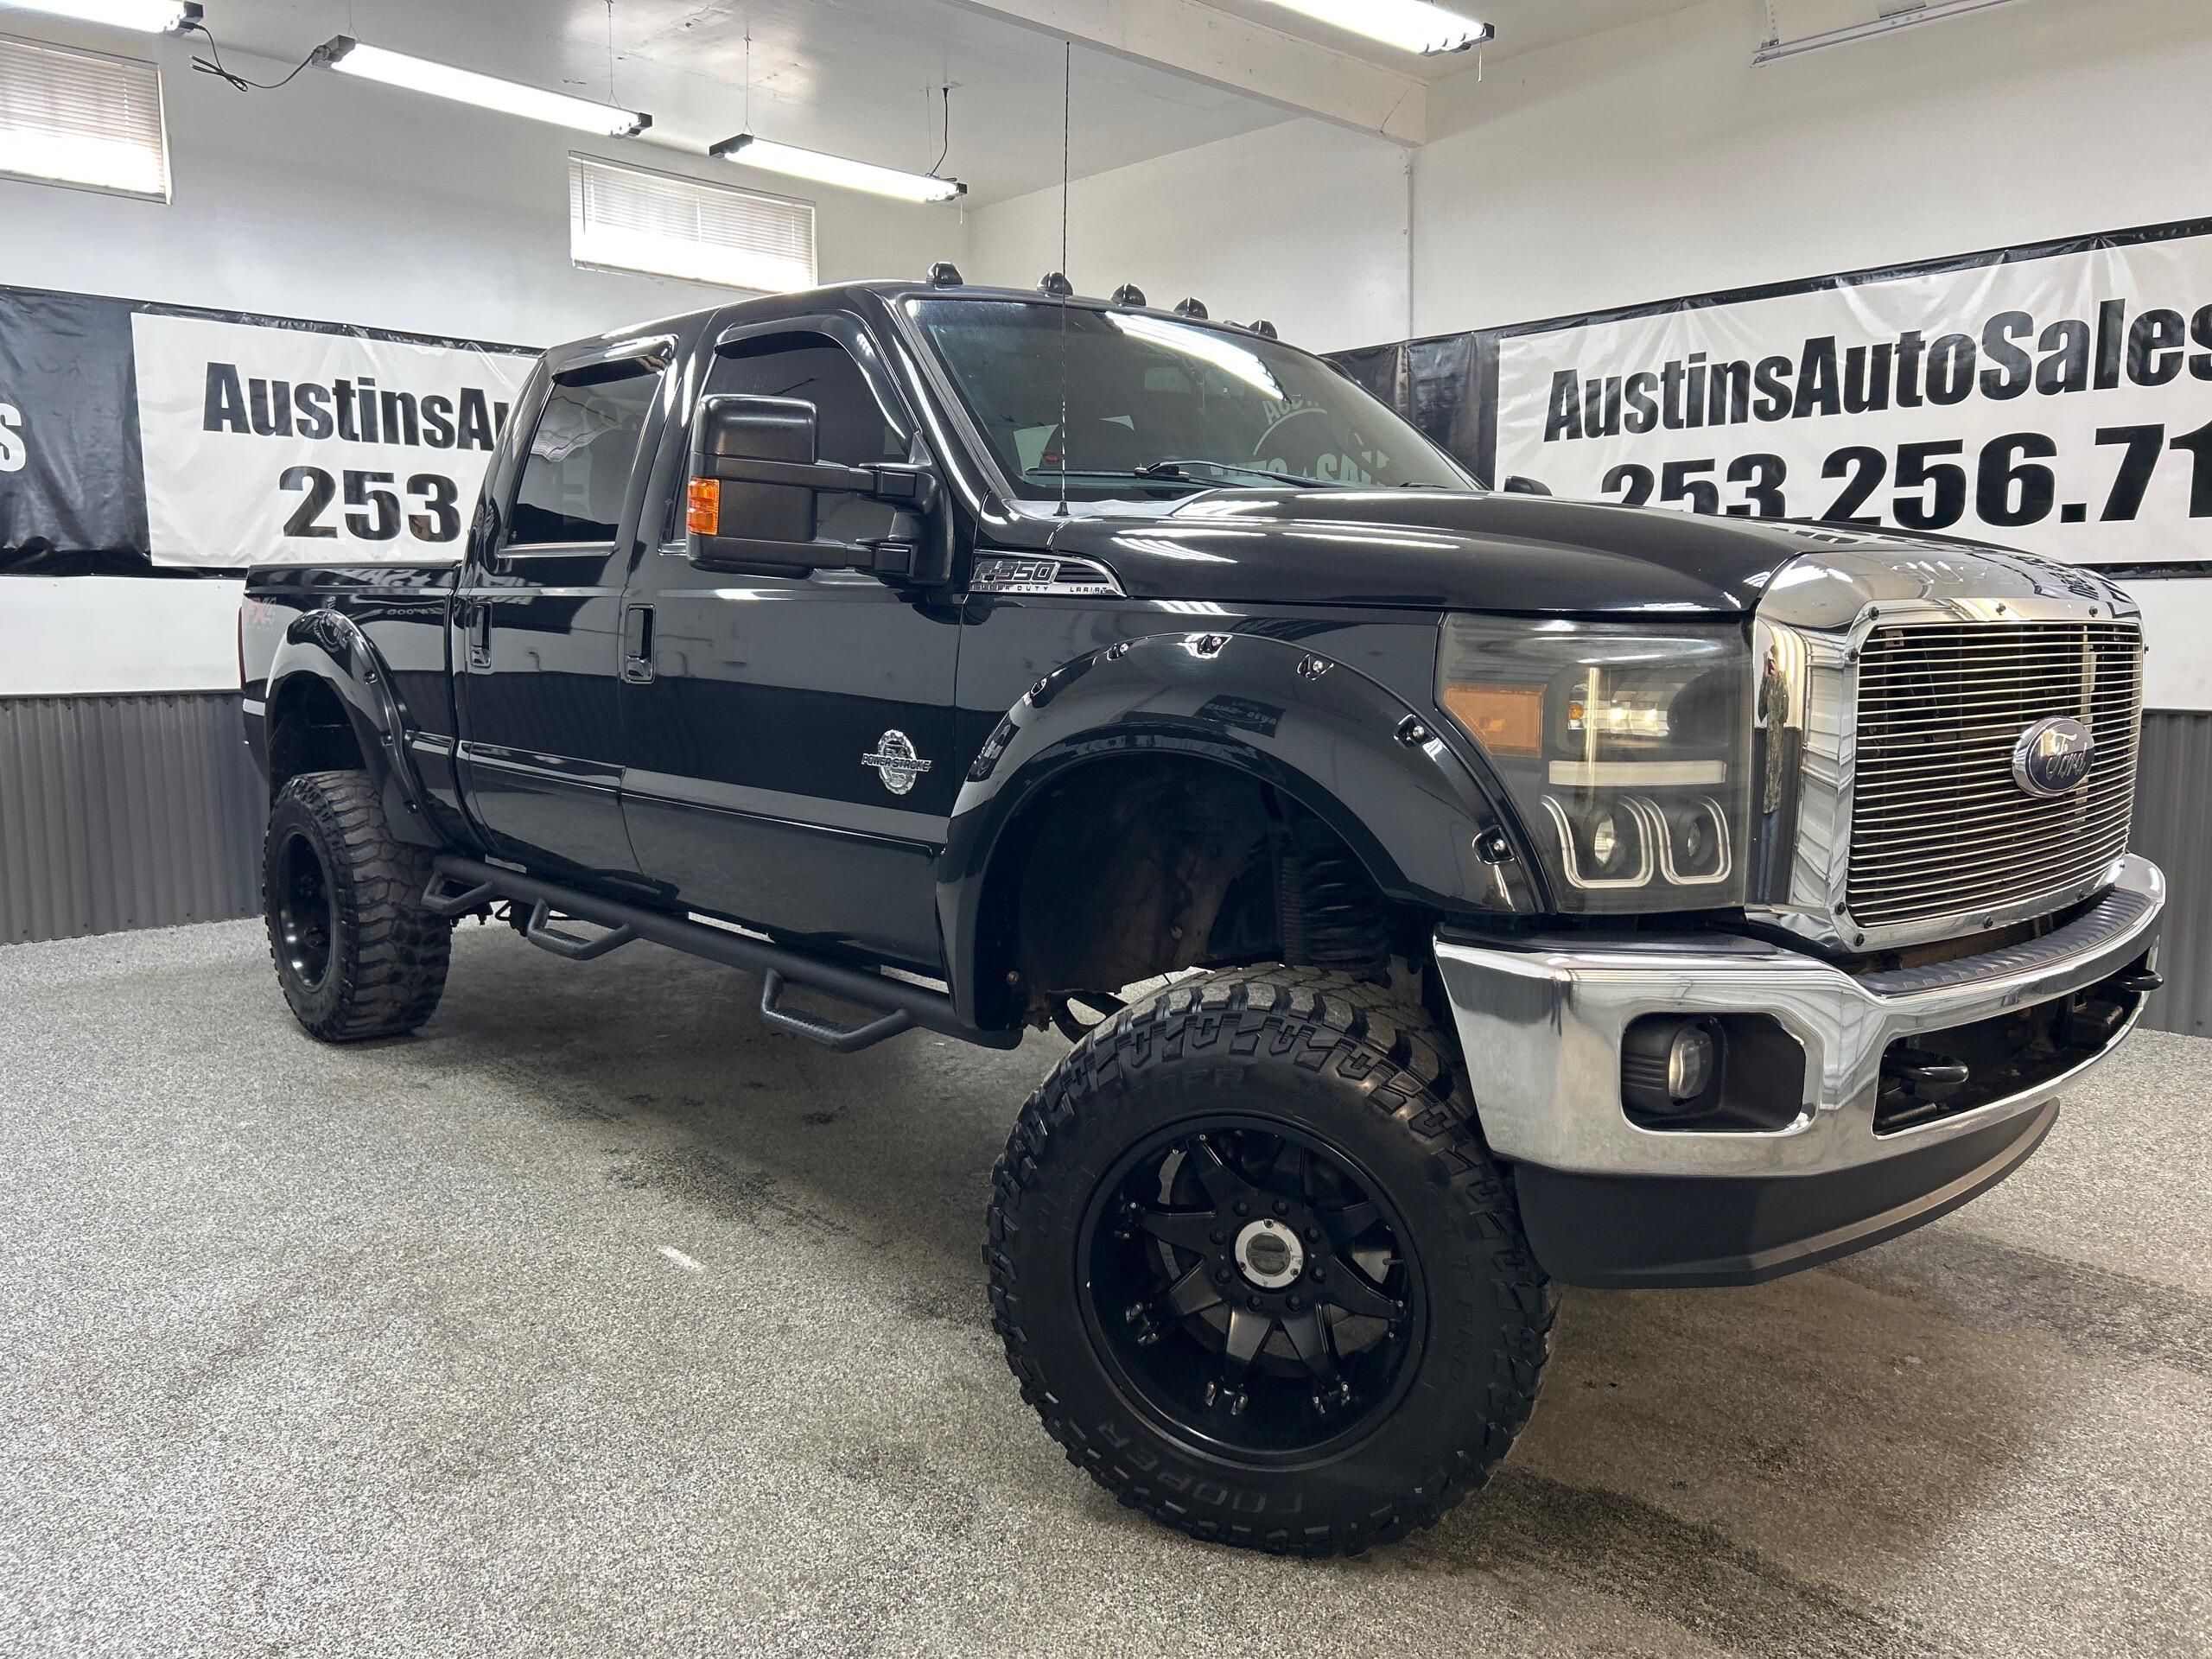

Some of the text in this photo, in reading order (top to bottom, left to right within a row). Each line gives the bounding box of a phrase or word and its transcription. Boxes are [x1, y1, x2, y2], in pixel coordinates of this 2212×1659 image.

[279, 465, 470, 542] 253
[1600, 420, 2212, 528] 253256.71
[2040, 728, 2088, 780] Ford
